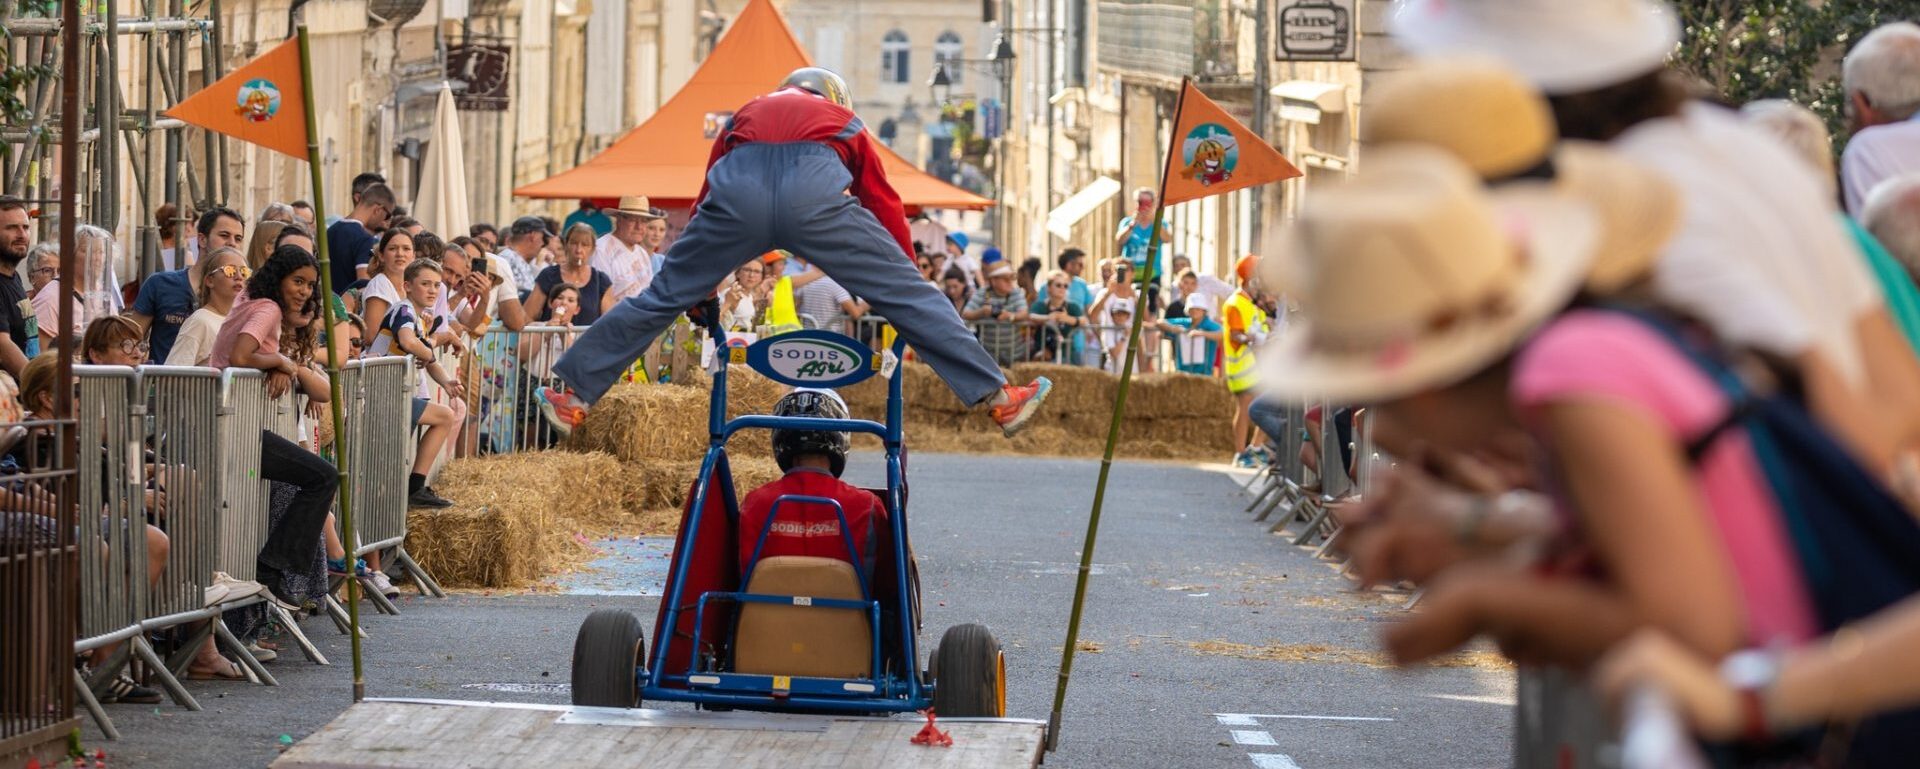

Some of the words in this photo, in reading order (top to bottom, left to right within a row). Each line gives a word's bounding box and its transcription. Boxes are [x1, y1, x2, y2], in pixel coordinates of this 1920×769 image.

[772, 349, 839, 360] SODIS
[796, 360, 845, 378] Agri
[771, 523, 806, 533] SODIS
